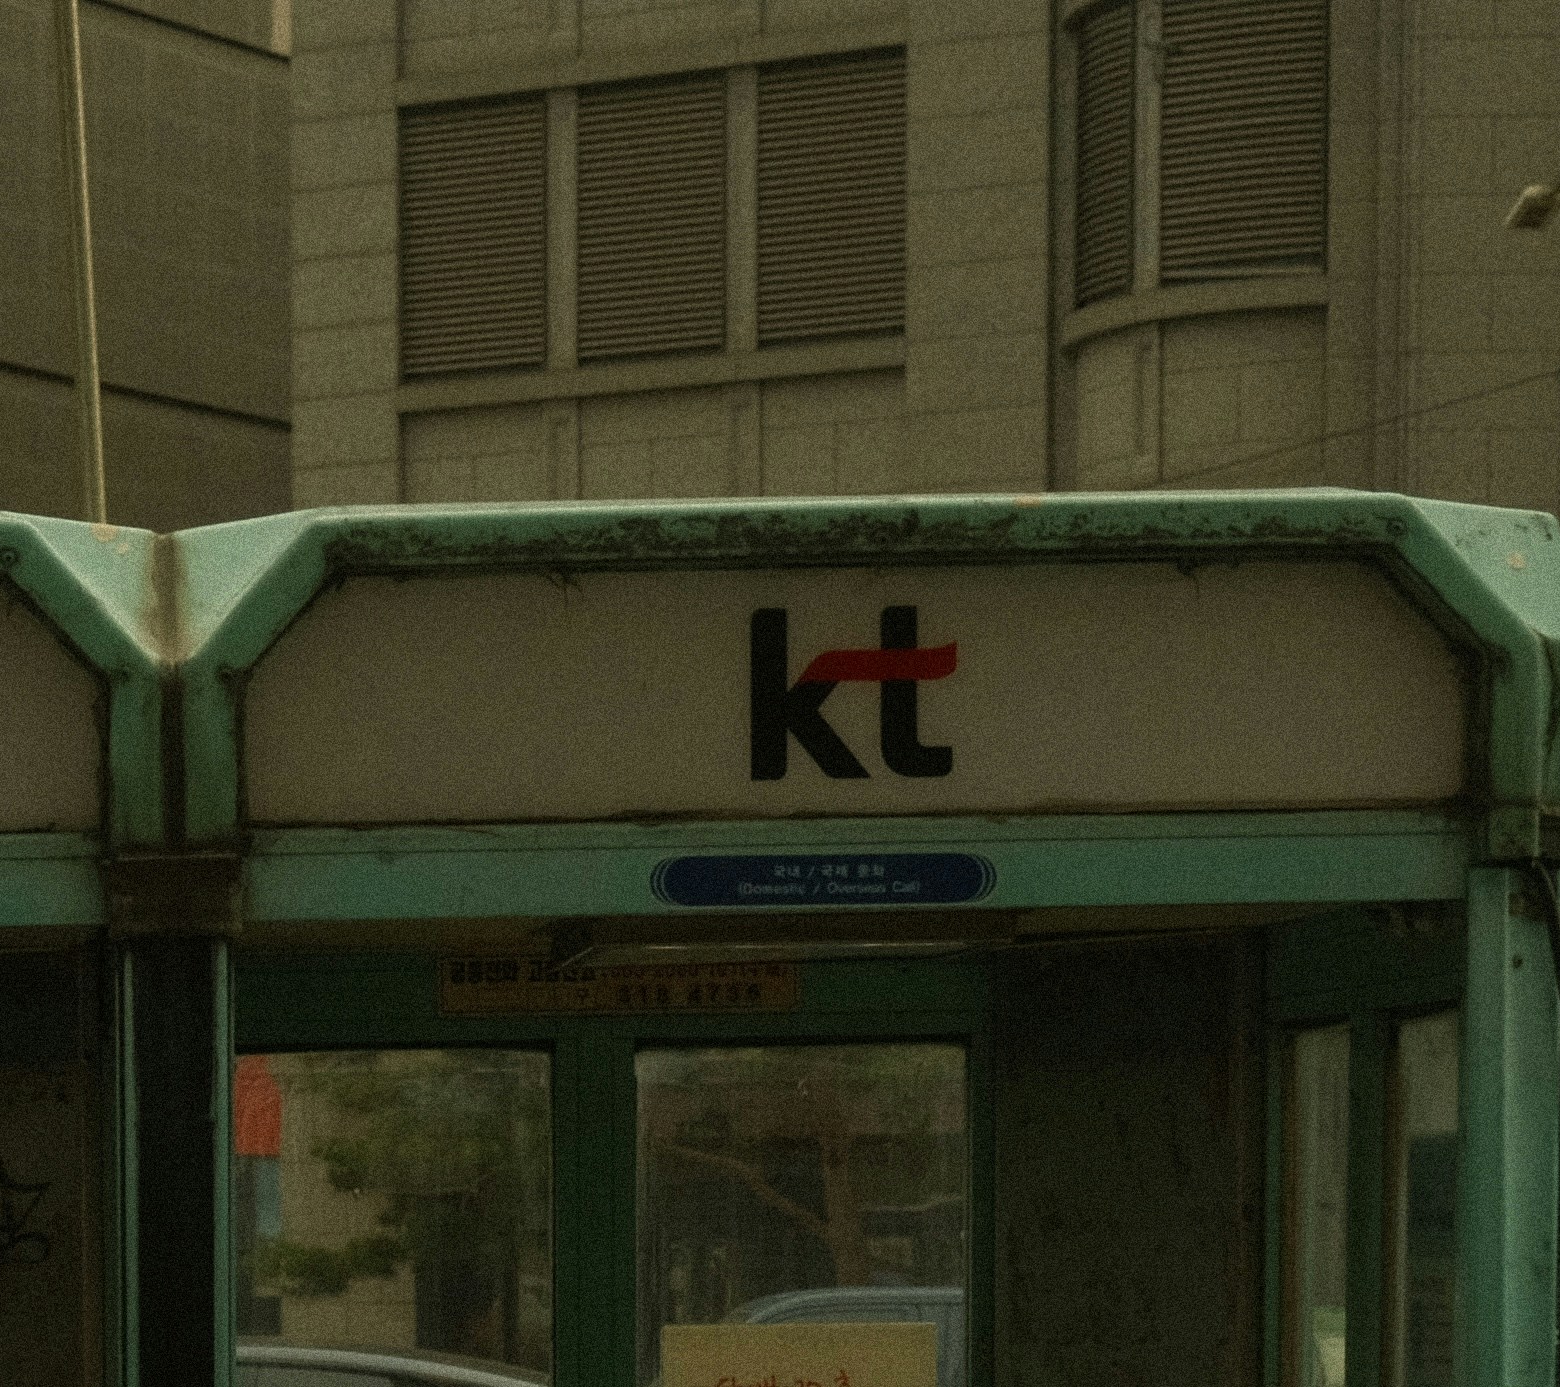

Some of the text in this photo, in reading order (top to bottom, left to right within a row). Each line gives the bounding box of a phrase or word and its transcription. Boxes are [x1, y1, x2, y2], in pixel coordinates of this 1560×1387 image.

[750, 605, 958, 781] kt
[773, 864, 801, 879] 국내
[821, 864, 849, 878] 국제
[857, 864, 886, 878] 통화
[737, 881, 805, 896] (Domestic
[827, 881, 887, 895] Overseas
[892, 880, 921, 894] Call)
